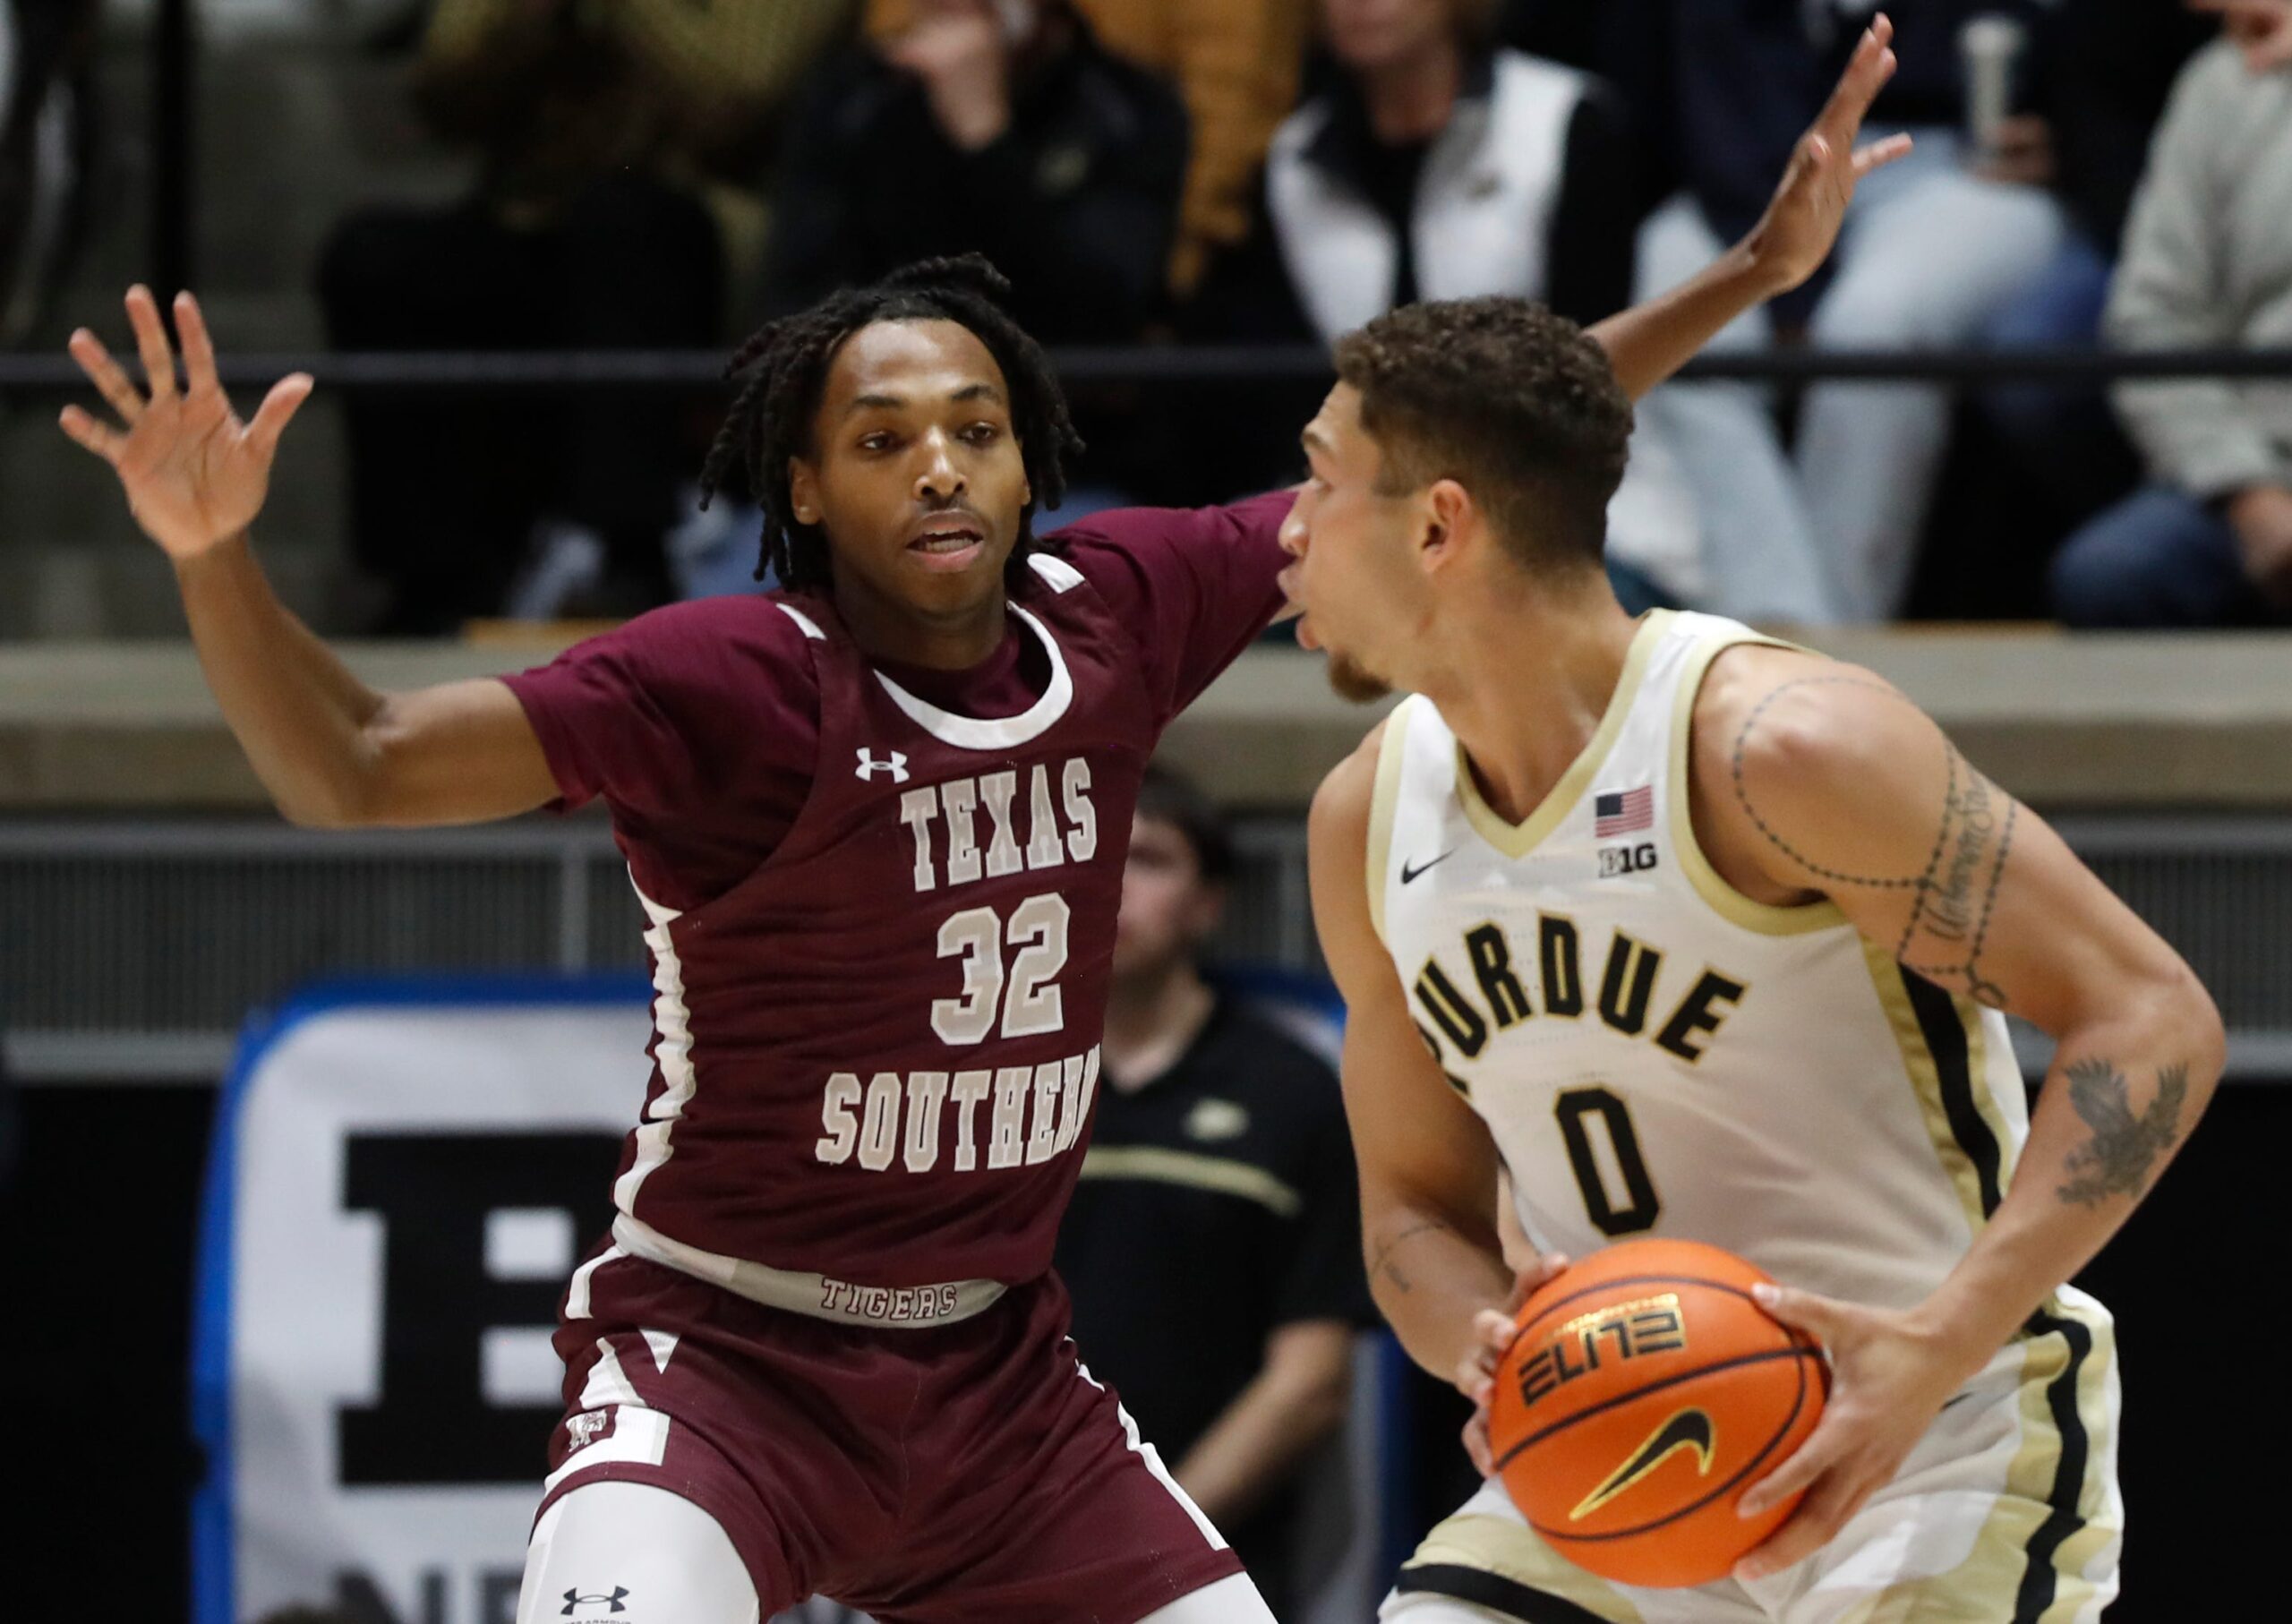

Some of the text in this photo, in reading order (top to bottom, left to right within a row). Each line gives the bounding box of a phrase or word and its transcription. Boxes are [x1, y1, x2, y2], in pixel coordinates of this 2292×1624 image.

[901, 757, 1097, 892] TEXAS
[930, 892, 1070, 1045] 32
[1554, 1085, 1661, 1237] 0
[821, 1278, 957, 1321] TIGERS
[1518, 1309, 1685, 1407] ELITE
